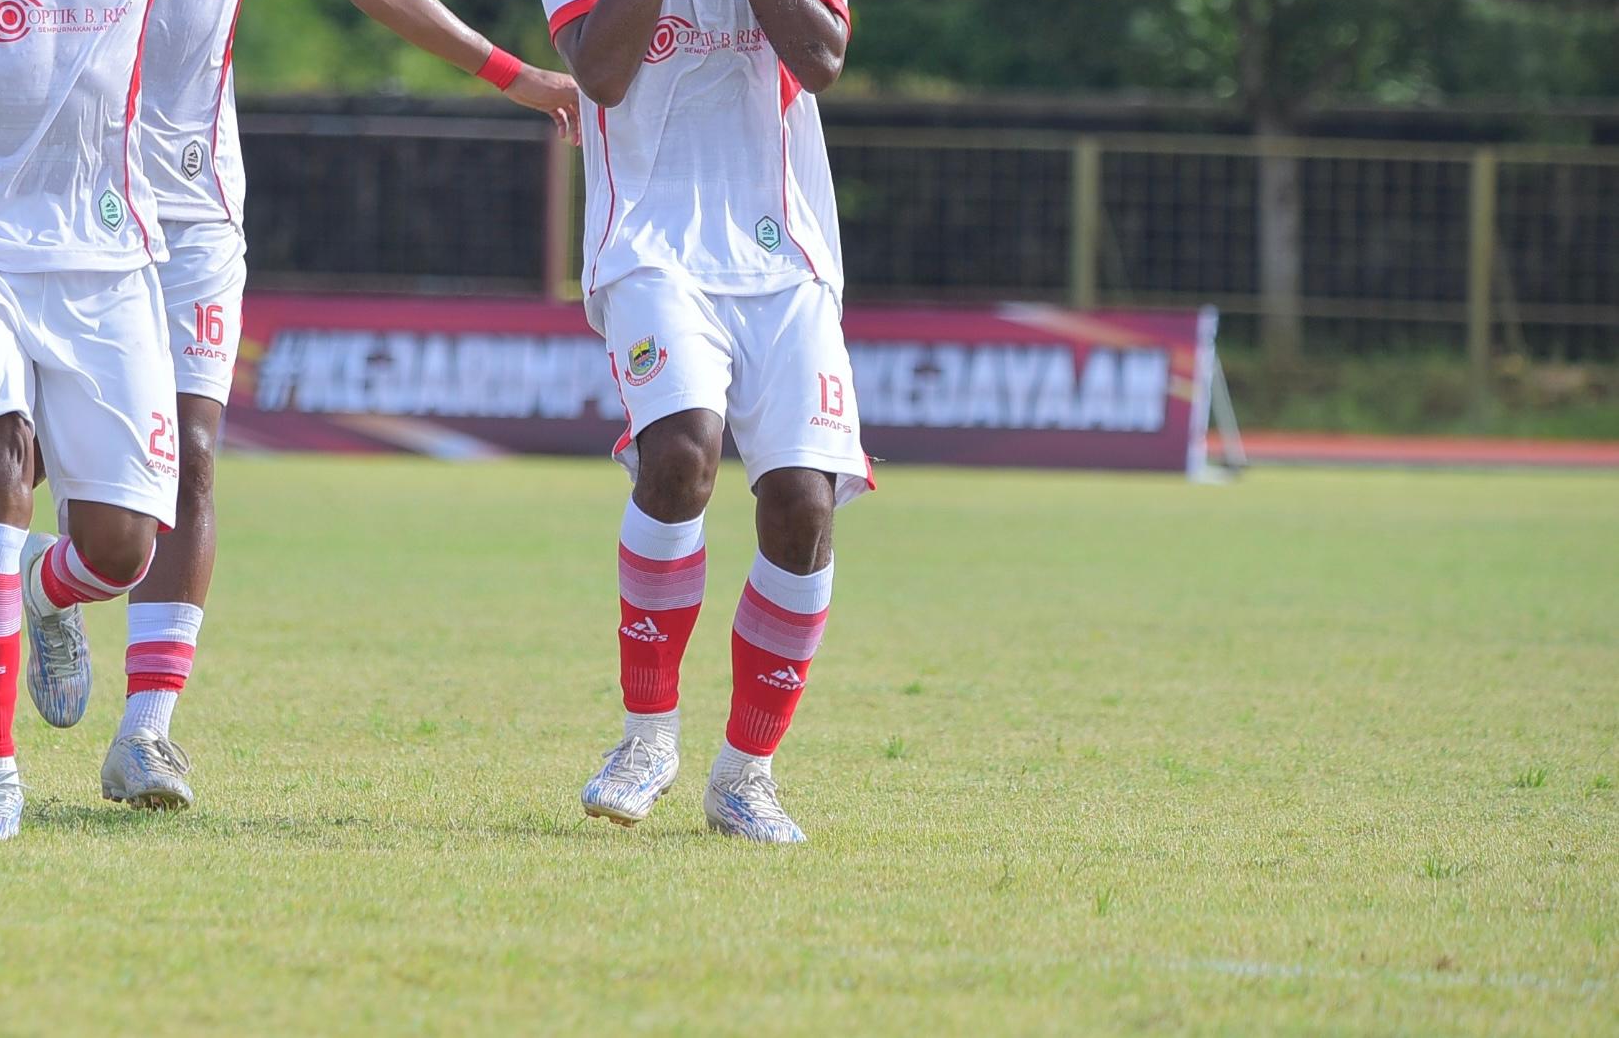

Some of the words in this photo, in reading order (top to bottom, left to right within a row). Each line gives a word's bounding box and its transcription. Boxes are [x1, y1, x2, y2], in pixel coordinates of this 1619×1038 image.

[28, 8, 78, 24] OPTIK
[85, 8, 97, 23] B.
[37, 25, 91, 34] SEMPURNAKAN
[194, 302, 224, 346] 16
[183, 346, 227, 363] ARAFS
[818, 372, 844, 417] 13
[810, 416, 852, 434] ARAFS
[149, 411, 176, 462] 23
[146, 459, 178, 479] ARAFS
[620, 626, 669, 643] ARAFS
